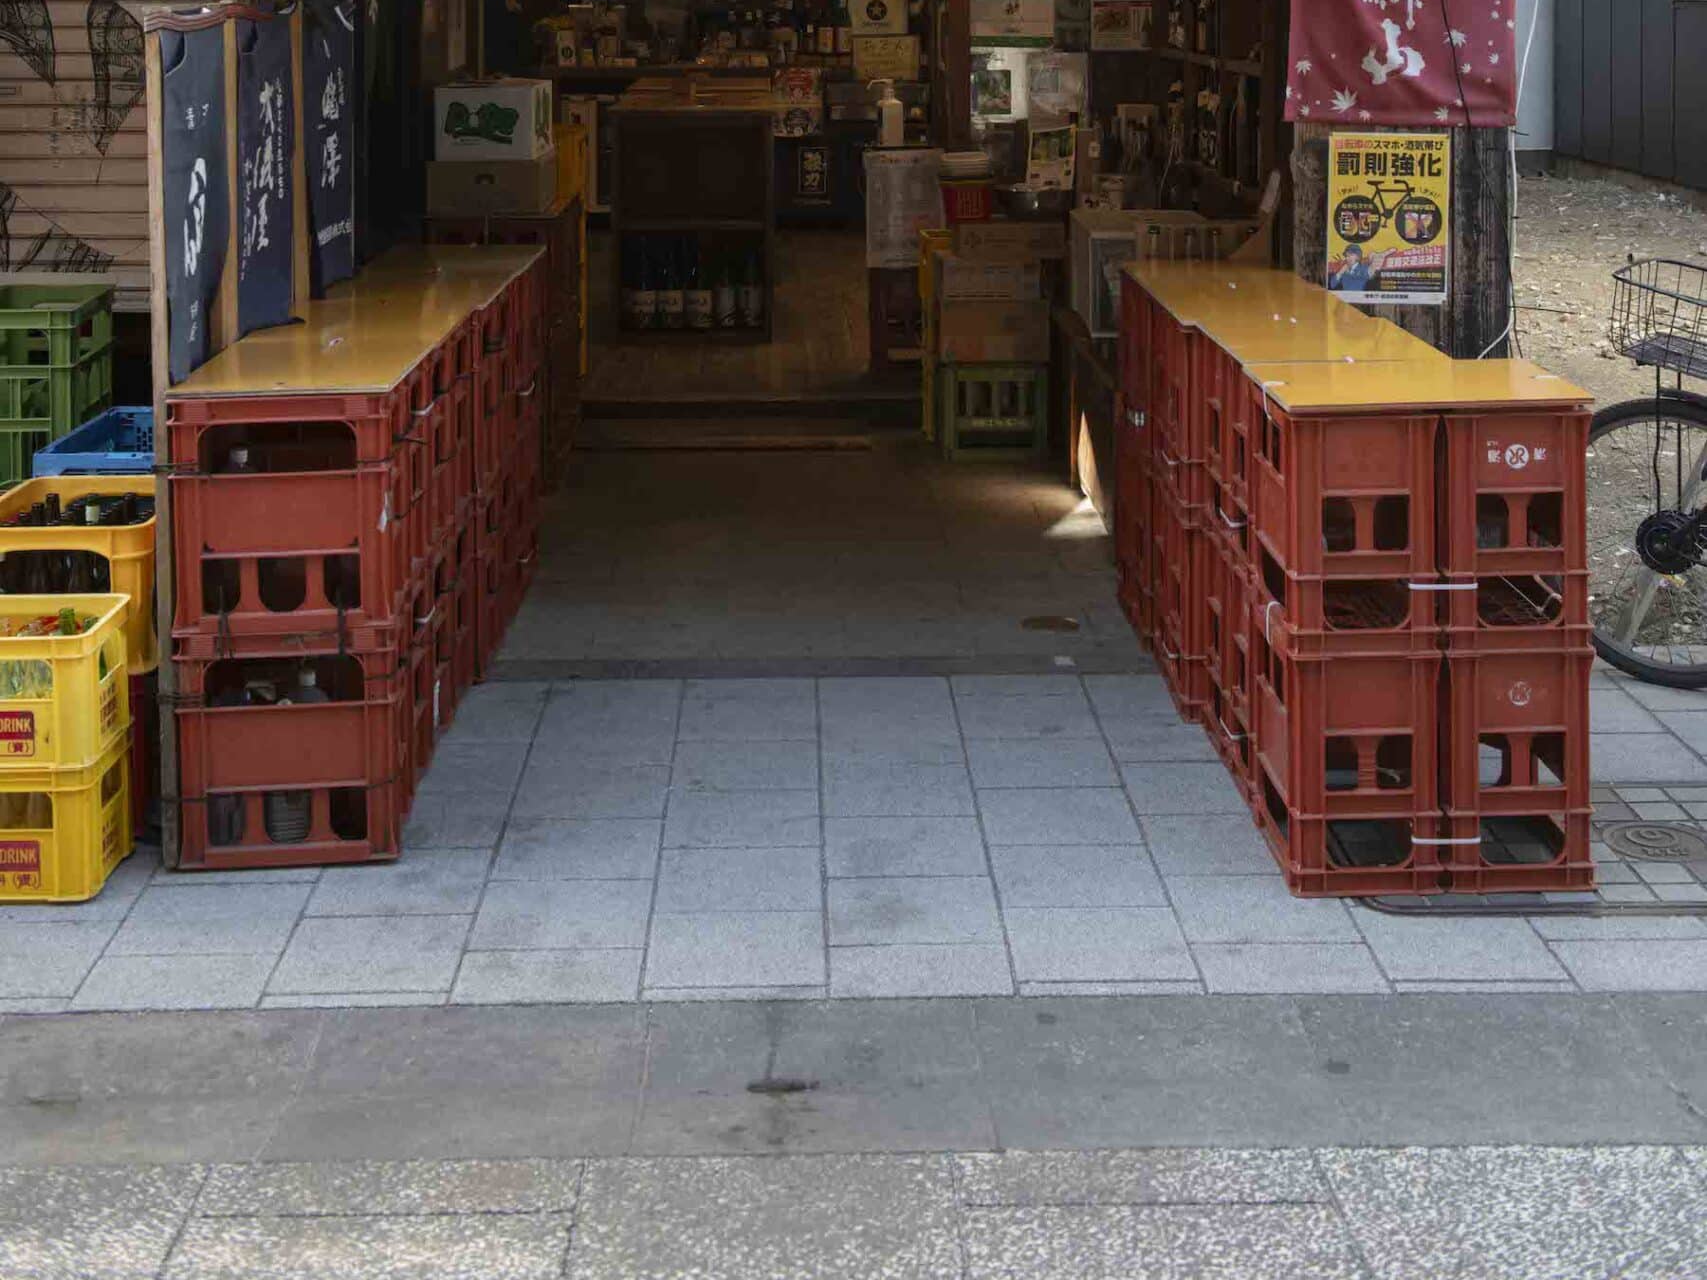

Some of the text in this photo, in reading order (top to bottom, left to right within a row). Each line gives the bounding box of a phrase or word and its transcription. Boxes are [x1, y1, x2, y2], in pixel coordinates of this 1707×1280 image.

[1336, 152, 1442, 177] 罰則強化
[0, 718, 32, 733] DRINK
[0, 847, 38, 864] DRINK
